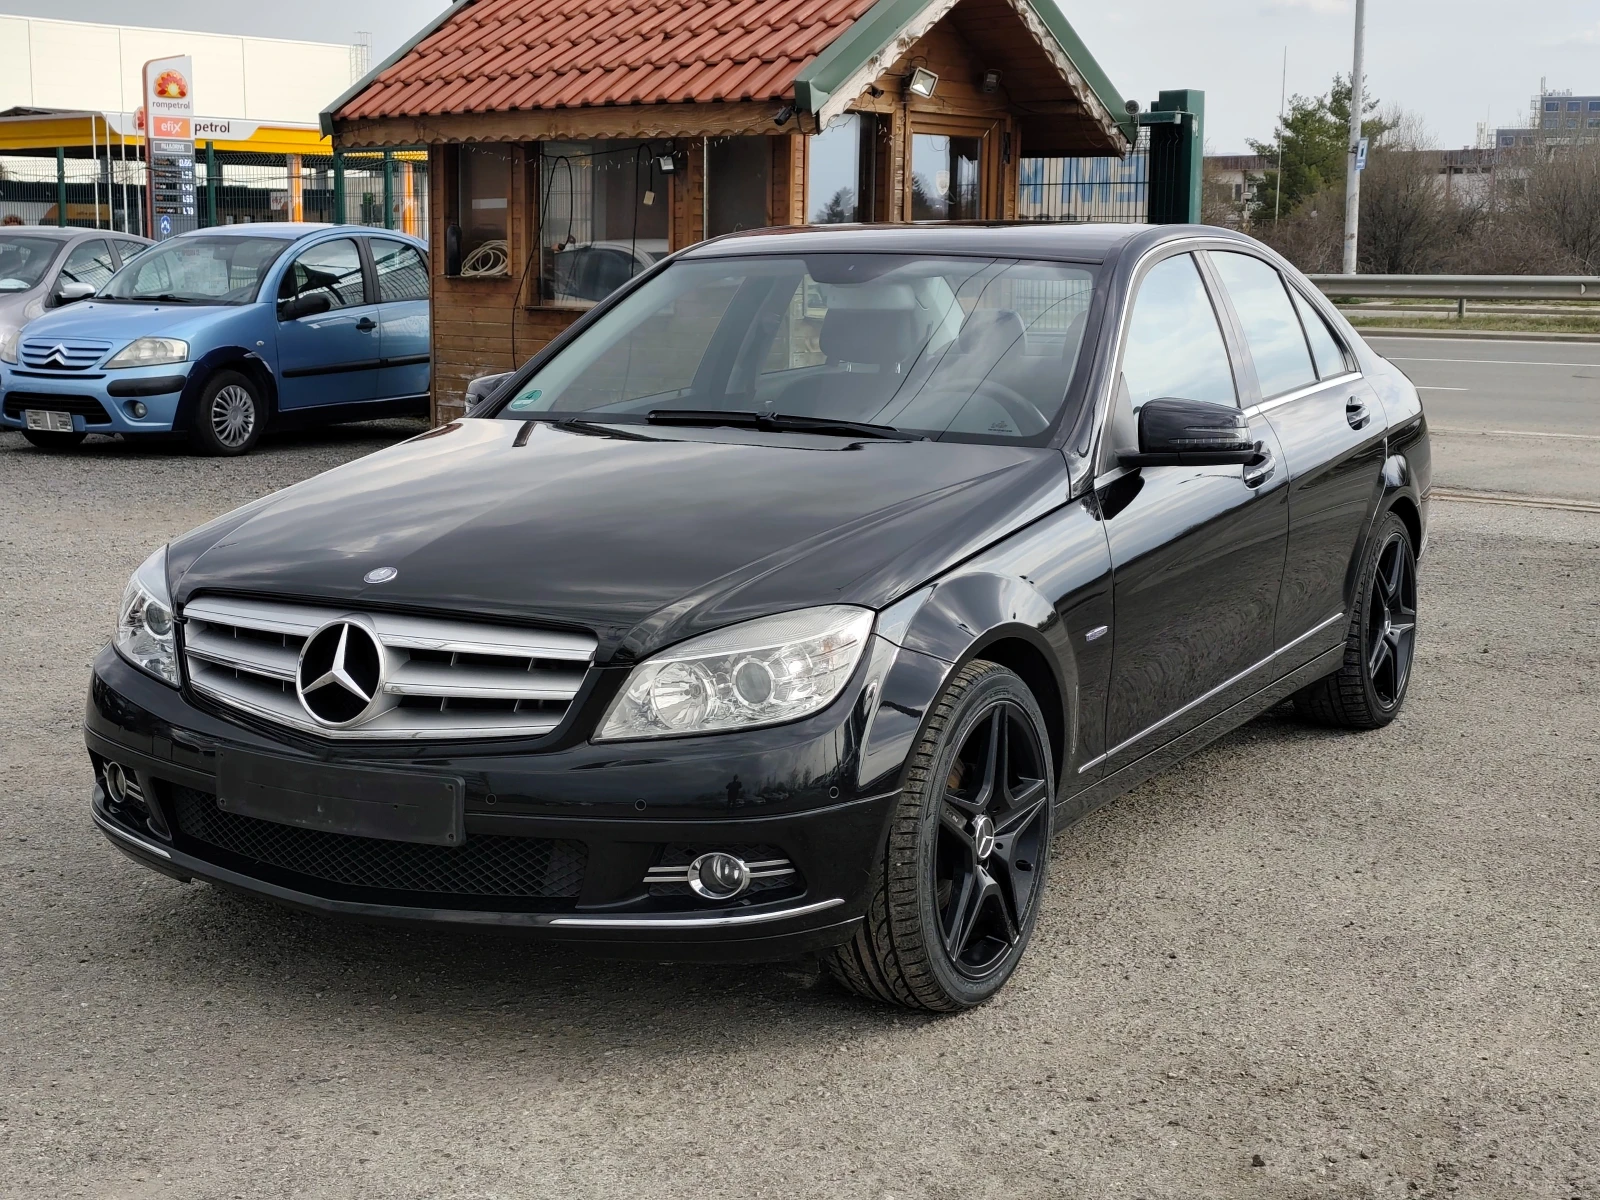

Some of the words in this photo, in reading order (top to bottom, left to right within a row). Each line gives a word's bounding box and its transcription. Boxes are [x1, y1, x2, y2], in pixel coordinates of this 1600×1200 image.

[152, 101, 190, 111] rompetrol
[161, 121, 183, 135] efix
[194, 121, 230, 135] petrol
